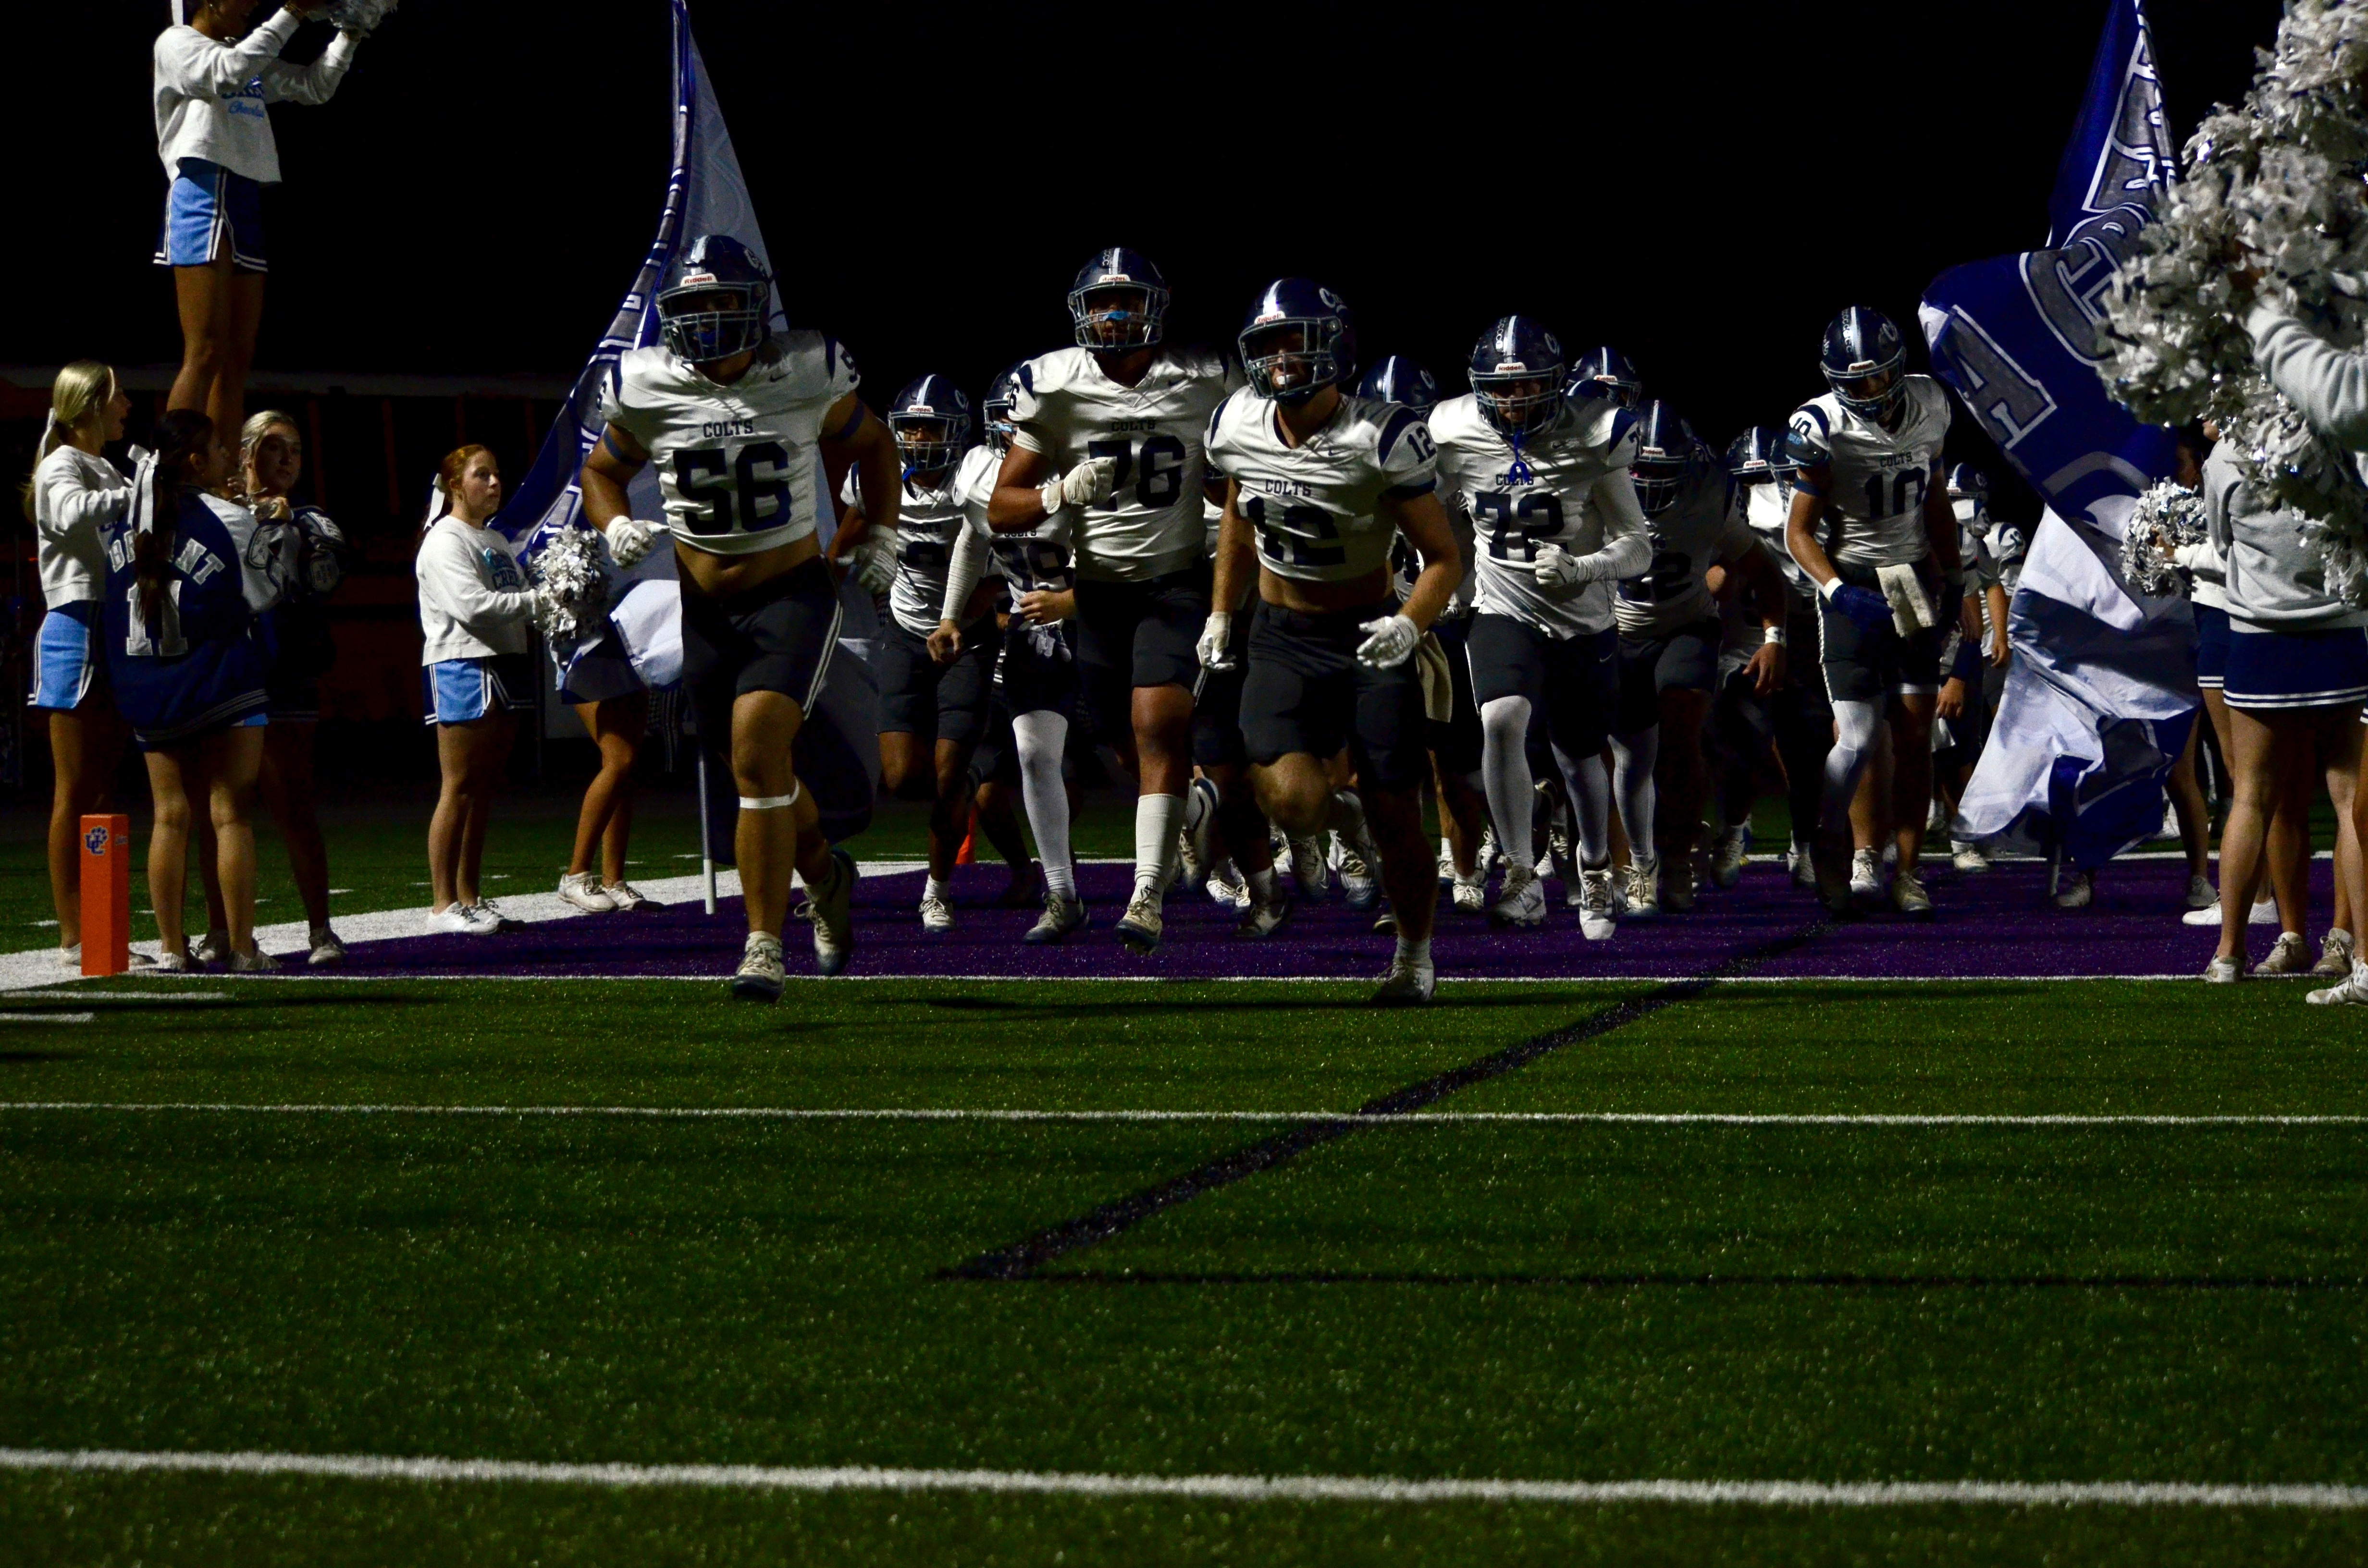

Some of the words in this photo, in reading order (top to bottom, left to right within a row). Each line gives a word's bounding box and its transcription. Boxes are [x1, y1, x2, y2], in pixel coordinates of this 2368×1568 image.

[703, 419, 754, 438] COLTS
[1111, 419, 1156, 431] COLTS
[1407, 426, 1437, 464] 12
[1087, 436, 1185, 512] 76
[1880, 452, 1912, 467] COLTS
[673, 441, 792, 535] 56
[1265, 479, 1311, 497] COLTS
[1865, 466, 1925, 519] 10
[1246, 496, 1346, 566] 12
[1475, 491, 1569, 562] 72
[109, 528, 226, 586] BRNT
[126, 578, 189, 657] 11
